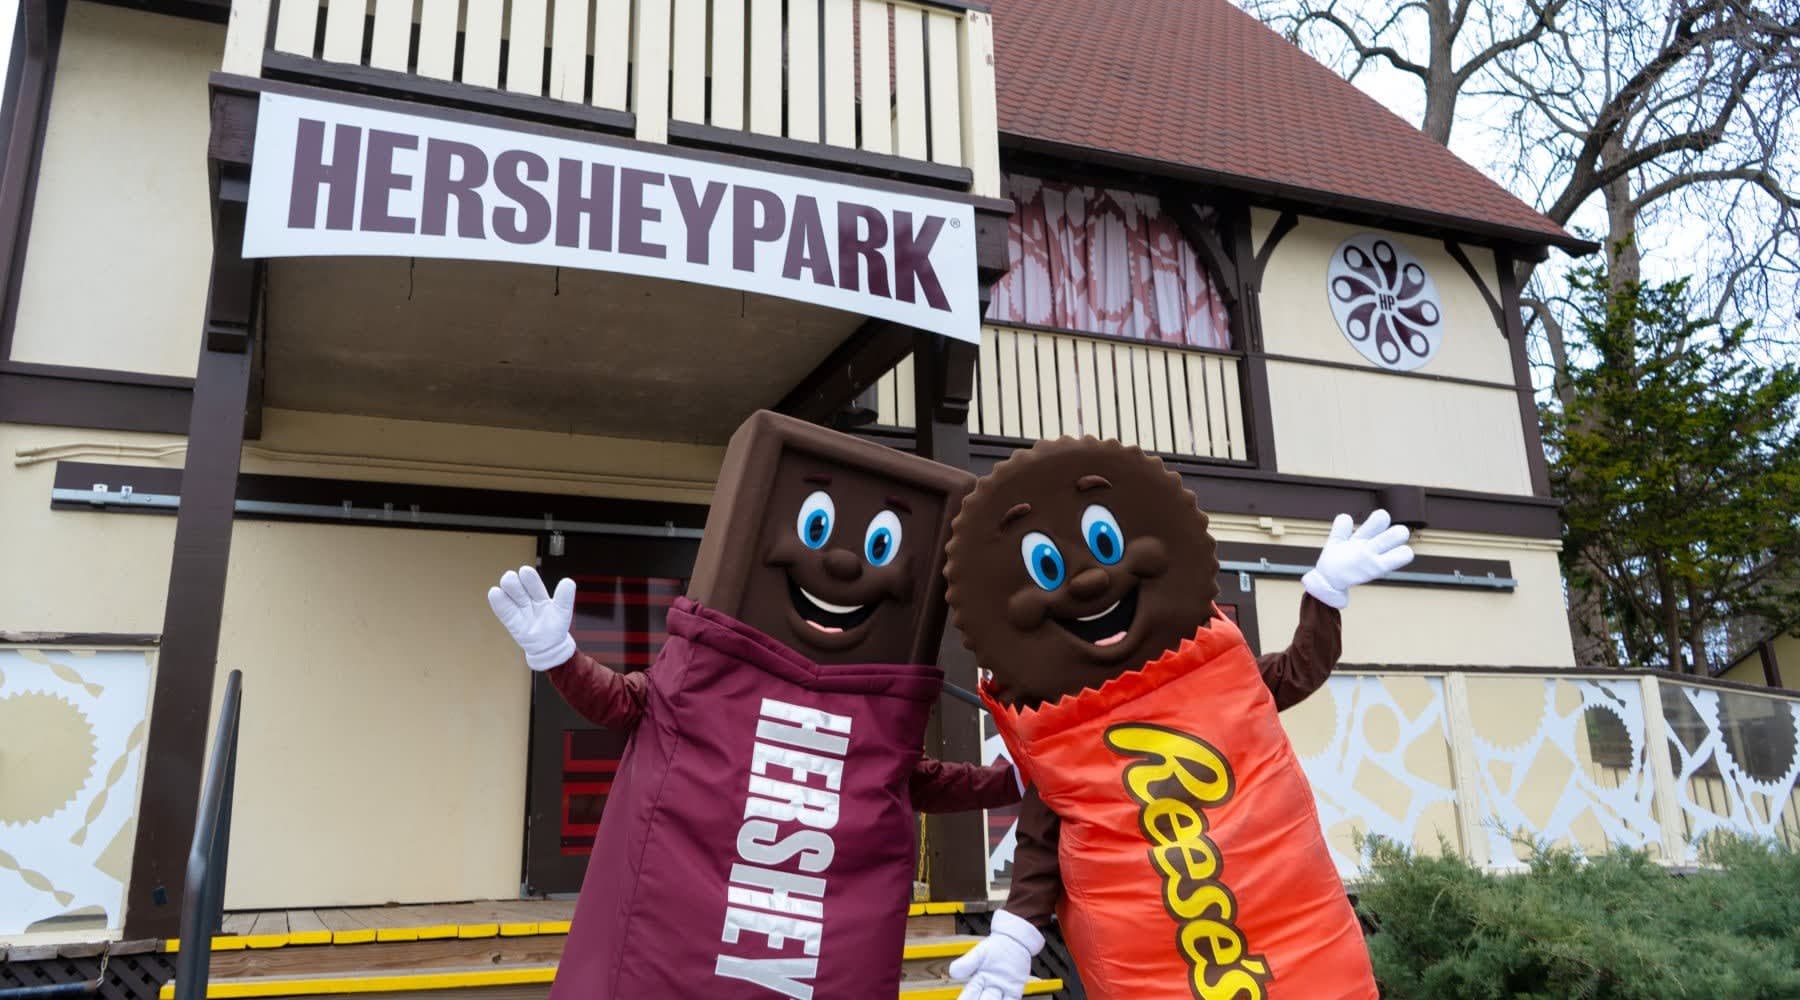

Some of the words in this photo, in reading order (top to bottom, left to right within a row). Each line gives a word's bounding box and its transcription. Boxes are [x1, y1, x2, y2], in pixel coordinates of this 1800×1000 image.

[1379, 294, 1395, 310] HP
[715, 698, 852, 1000] HERSHEY
[1105, 724, 1271, 1000] Reese's
